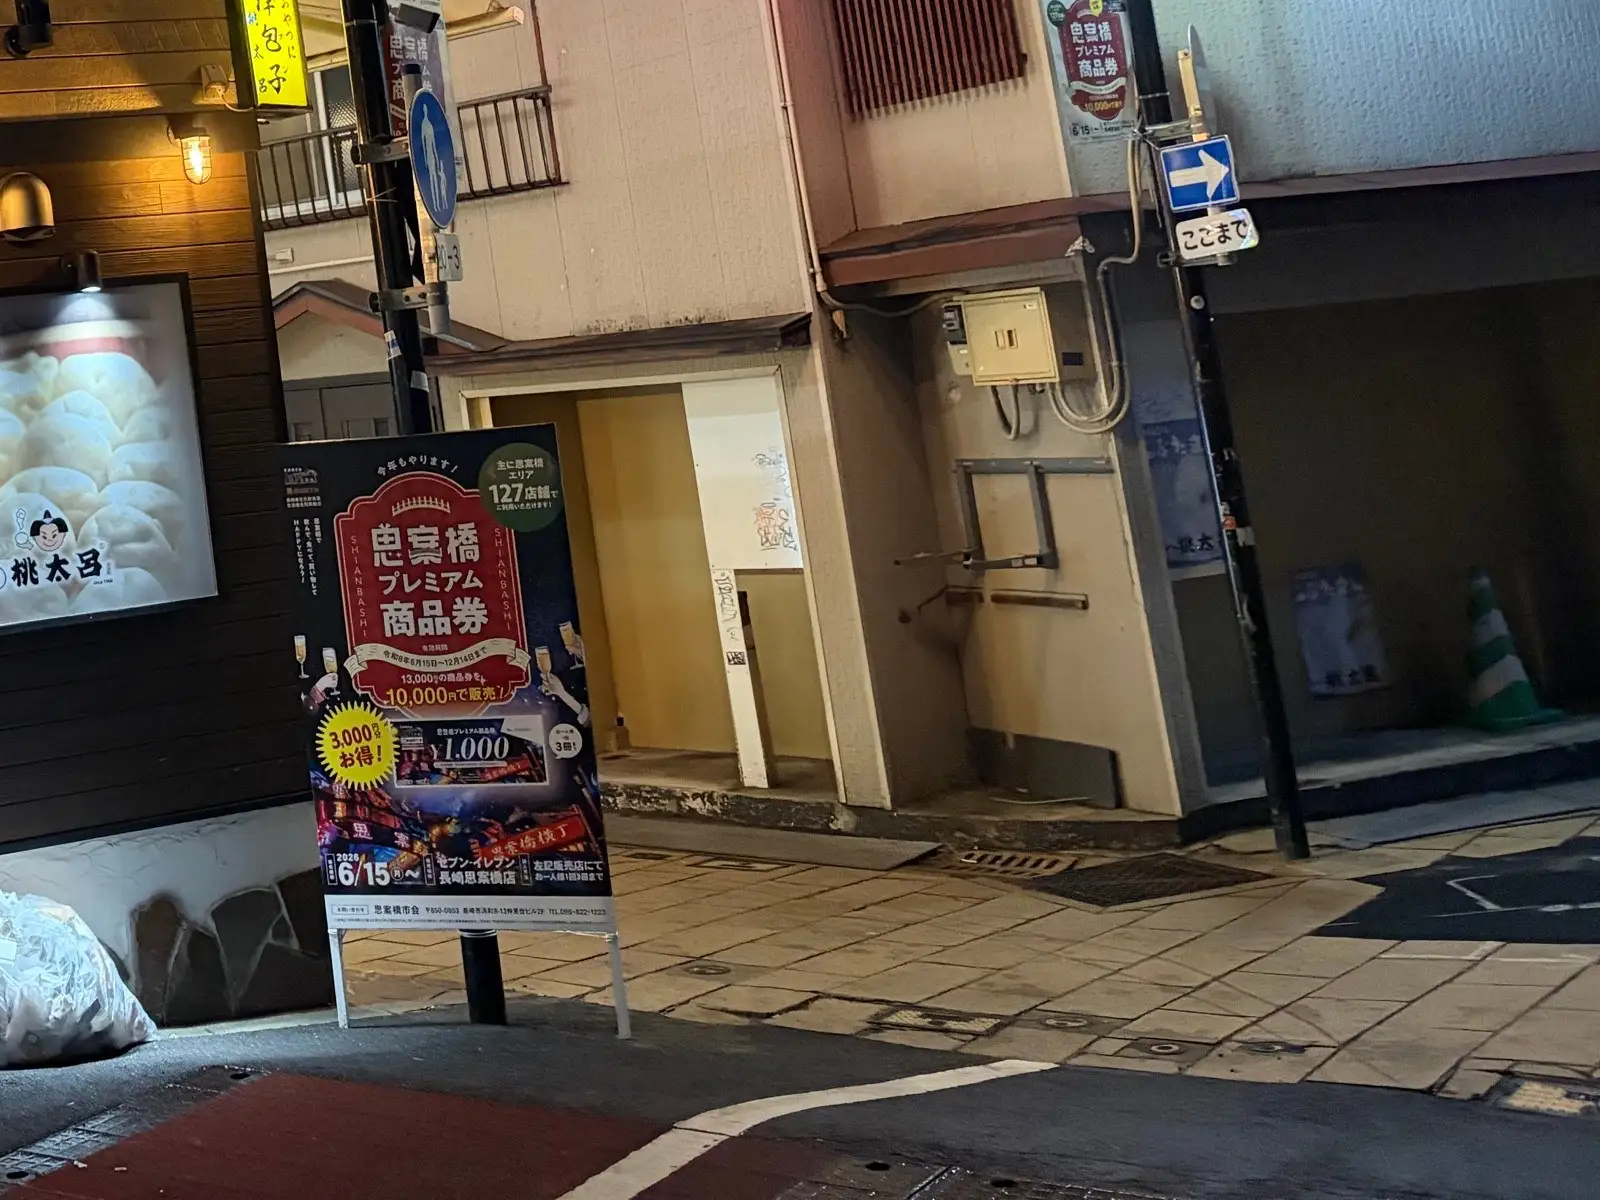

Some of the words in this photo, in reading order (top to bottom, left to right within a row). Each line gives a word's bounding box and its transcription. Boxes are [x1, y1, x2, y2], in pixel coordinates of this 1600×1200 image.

[1077, 57, 1119, 79] 商品券
[1182, 218, 1248, 250] ここまで
[377, 454, 459, 477] 今年もやります!
[496, 456, 544, 471] 主に思案橋
[508, 470, 534, 480] エリア
[488, 483, 560, 504] 127店舗で
[371, 522, 481, 567] 思案橋
[10, 548, 103, 587] 桃太呂
[378, 569, 484, 595] プレミアム
[379, 596, 489, 638] 商品券
[339, 745, 382, 768] お得!
[336, 853, 360, 862] 2026
[338, 861, 391, 887] 6/15
[438, 870, 516, 885] 長崎思案橋店
[374, 904, 420, 915] 思案橋市会
